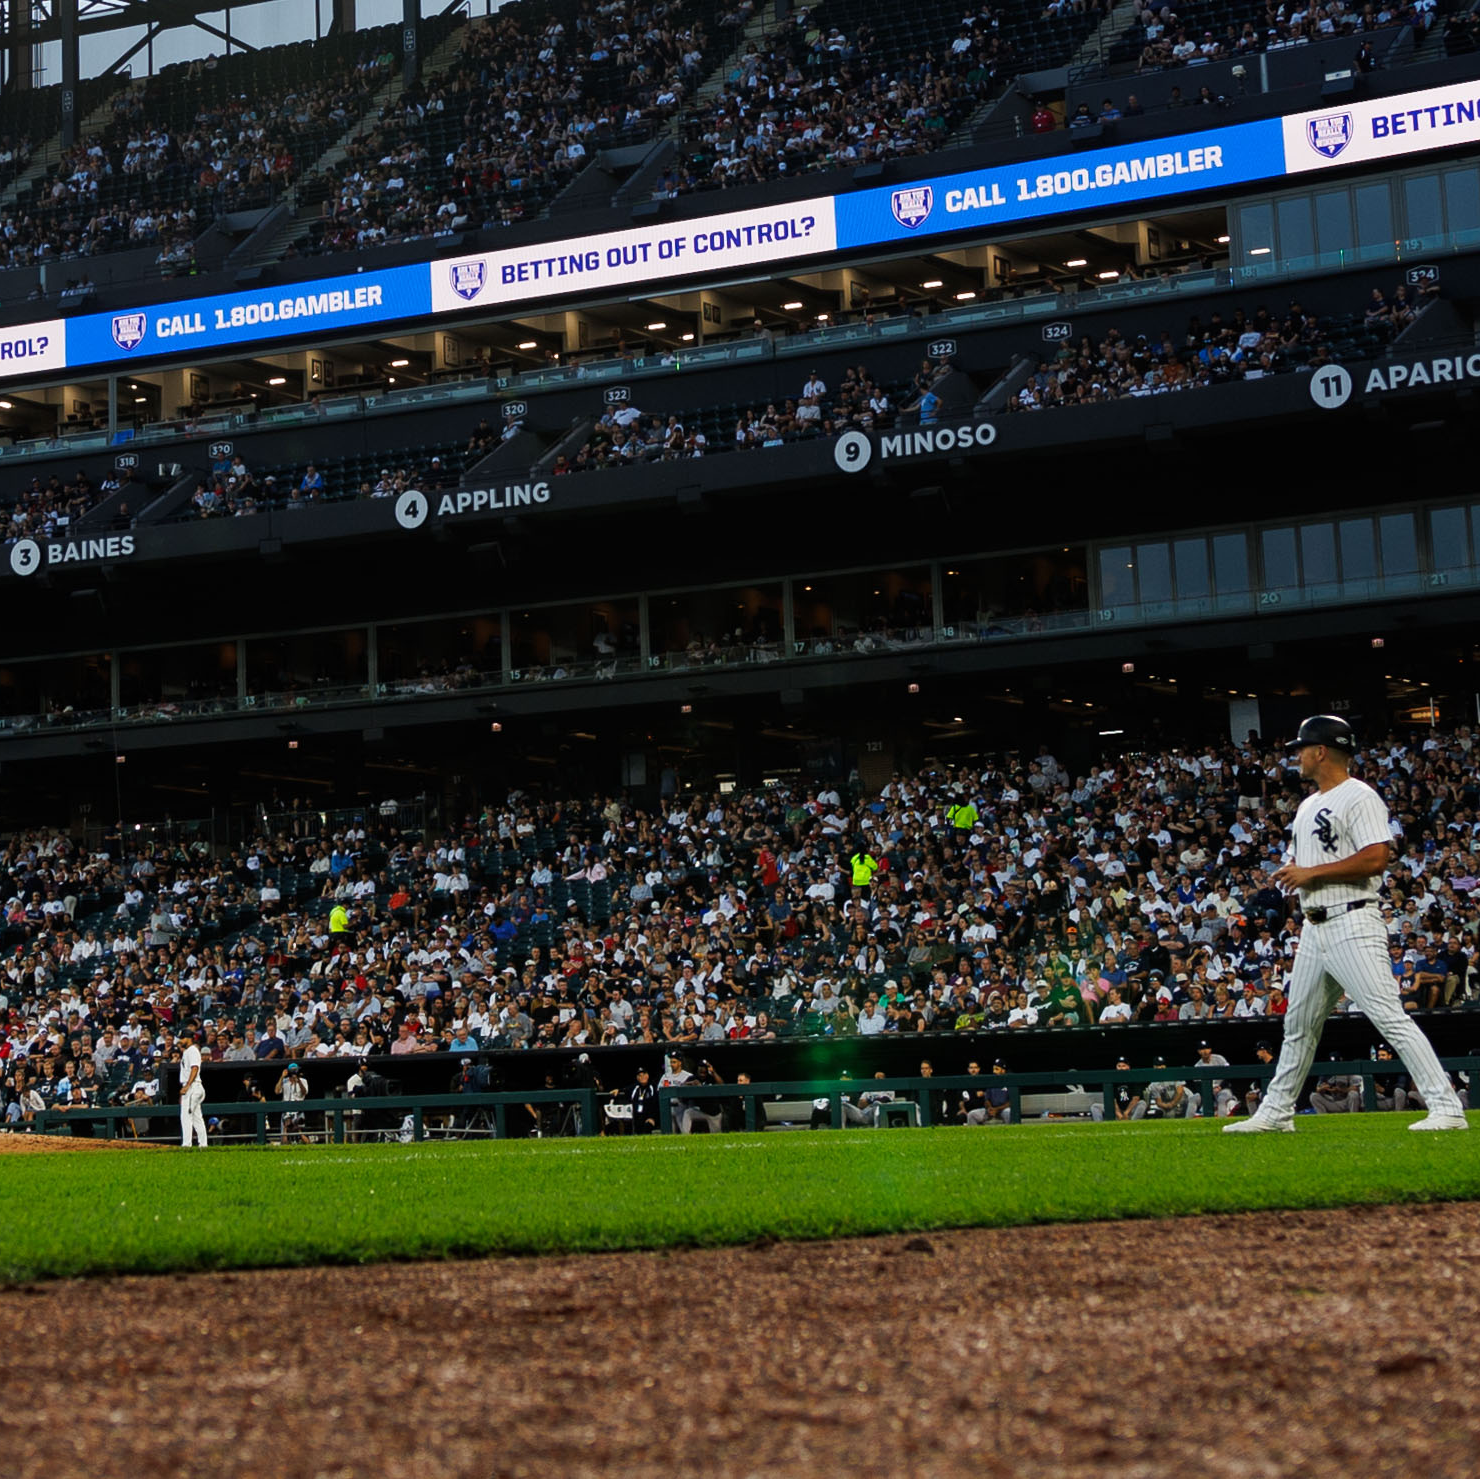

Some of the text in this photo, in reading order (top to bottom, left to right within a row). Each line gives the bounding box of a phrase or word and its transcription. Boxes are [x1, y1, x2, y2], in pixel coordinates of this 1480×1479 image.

[945, 183, 1006, 213] CALL
[1017, 145, 1223, 202] 1.800.GAMBLER
[501, 251, 600, 285] BETTING
[606, 243, 652, 267] OUT
[658, 237, 686, 259] OF
[693, 216, 815, 254] CONTROL?
[156, 312, 206, 338] CALL
[215, 285, 383, 329] 1.800.GAMBLER
[1046, 326, 1069, 339] 324
[931, 342, 953, 354] 322
[607, 389, 627, 401] 322
[1320, 377, 1343, 397] 11
[505, 403, 524, 415] 320
[846, 423, 997, 461] 9 MINOSO
[405, 481, 551, 518] 4 APPLING
[20, 535, 135, 567] 3 BAINES
[794, 643, 805, 652] 17
[1330, 699, 1350, 711] 123
